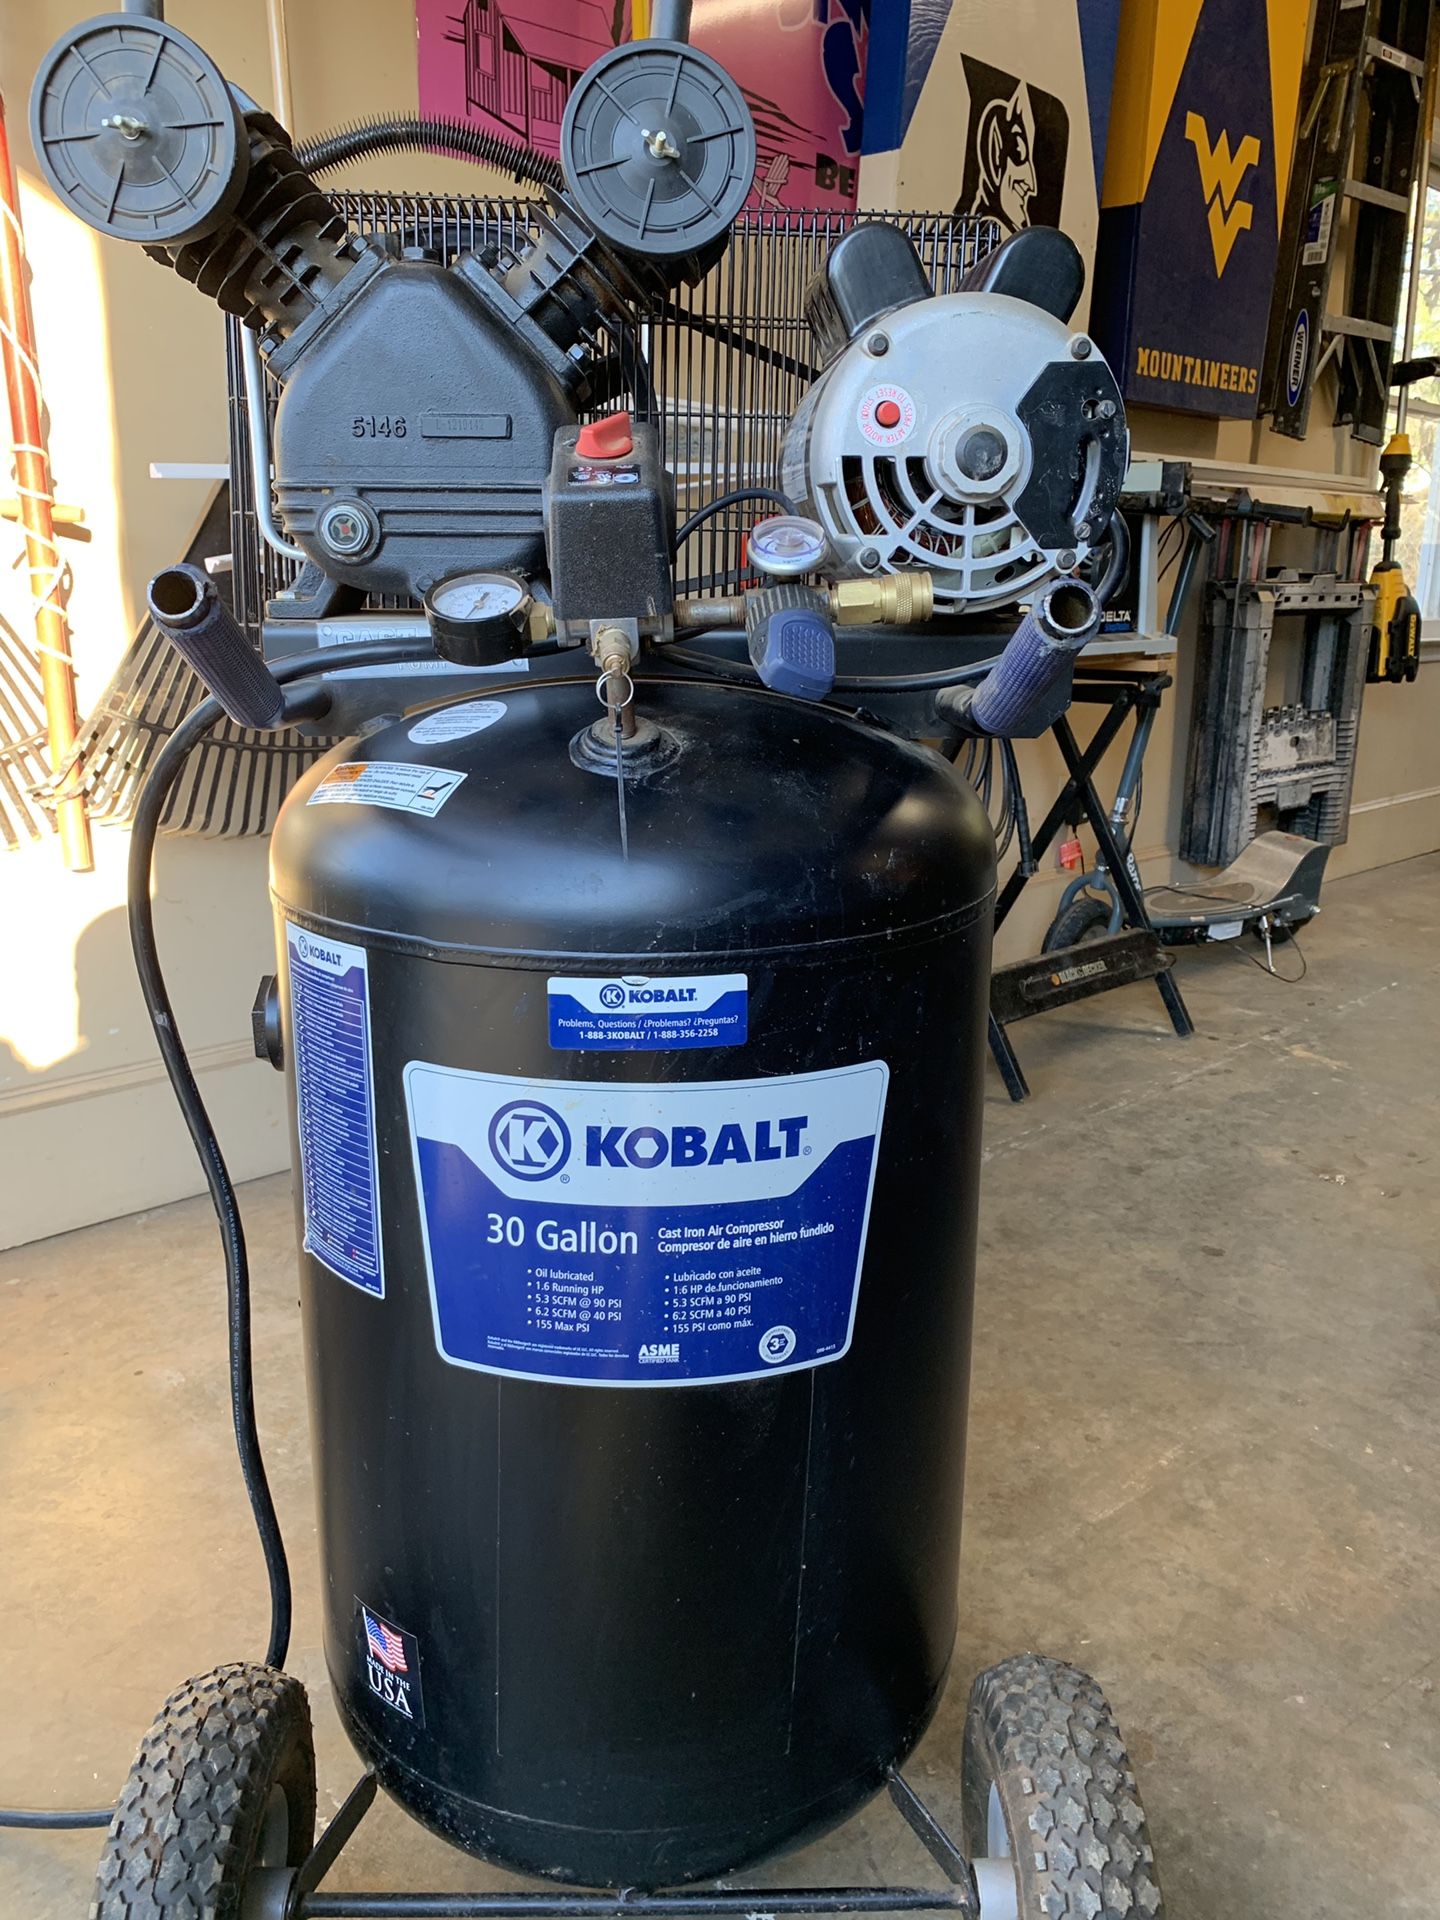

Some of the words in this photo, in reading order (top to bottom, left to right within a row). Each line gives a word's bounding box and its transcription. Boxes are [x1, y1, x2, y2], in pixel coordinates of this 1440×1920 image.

[1292, 330, 1305, 386] WERNER
[1136, 346, 1258, 394] MOUNTAINEERS
[352, 416, 407, 438] 5146
[309, 944, 342, 967] KOBALT
[629, 988, 697, 1003] KOBALT
[558, 1018, 596, 1029] Problems,
[598, 1020, 636, 1030] Questions
[643, 1018, 692, 1029] ¿Problemas?
[693, 1015, 739, 1027] ¿Preguntas?
[579, 1031, 645, 1040] 1-888-3KOBALT
[653, 1028, 719, 1039] 1-888-356-2258
[586, 1115, 809, 1169] KOBALT
[486, 1212, 525, 1247] 30
[536, 1219, 638, 1254] Gallon
[658, 1227, 681, 1239] Cast
[684, 1226, 705, 1238] Iron
[708, 1224, 723, 1236] Air
[725, 1219, 784, 1237] Compressor
[658, 1240, 714, 1255] Compresor
[717, 1238, 730, 1250] de
[733, 1237, 753, 1248] aire
[755, 1236, 767, 1245] en
[770, 1231, 798, 1244] hierro
[799, 1222, 835, 1239] fundido
[535, 1267, 548, 1278] Oil
[550, 1269, 594, 1281] lubricated
[673, 1270, 716, 1282] Lubricado
[718, 1271, 734, 1279] con
[736, 1266, 762, 1277] aceite
[536, 1281, 550, 1291] 1.6
[552, 1282, 589, 1296] Running
[591, 1285, 604, 1295] HP
[673, 1286, 688, 1295] 1.6
[690, 1285, 703, 1294] HP
[705, 1283, 716, 1293] de
[717, 1276, 783, 1292] funcionamiento
[535, 1294, 549, 1304] 5.3
[552, 1295, 577, 1306] SCFM
[579, 1297, 591, 1308] @
[593, 1298, 606, 1308] 90
[608, 1299, 622, 1308] PSI
[672, 1298, 687, 1308] 5.3
[690, 1297, 714, 1307] SCFM
[716, 1297, 722, 1305] a
[724, 1294, 736, 1304] 90
[738, 1293, 752, 1302] PSI
[535, 1306, 549, 1317] 6.2
[552, 1308, 577, 1319] SCFM
[579, 1310, 591, 1321] @
[593, 1311, 606, 1320] 40
[608, 1311, 622, 1321] PSI
[672, 1311, 687, 1321] 6.2
[689, 1309, 714, 1319] SCFM
[716, 1310, 722, 1318] a
[724, 1308, 736, 1316] 40
[738, 1306, 751, 1315] PSI
[536, 1319, 552, 1329] 155
[555, 1321, 574, 1331] Max
[576, 1323, 590, 1333] PSI
[672, 1324, 689, 1333] 155
[692, 1322, 705, 1332] PSI
[707, 1322, 732, 1331] como
[733, 1318, 754, 1328] máx.
[638, 1343, 680, 1356] ASME
[769, 1337, 780, 1351] 3
[366, 1654, 385, 1675] MADE
[385, 1669, 394, 1681] IN
[394, 1675, 411, 1692] THE
[367, 1662, 413, 1715] USA
